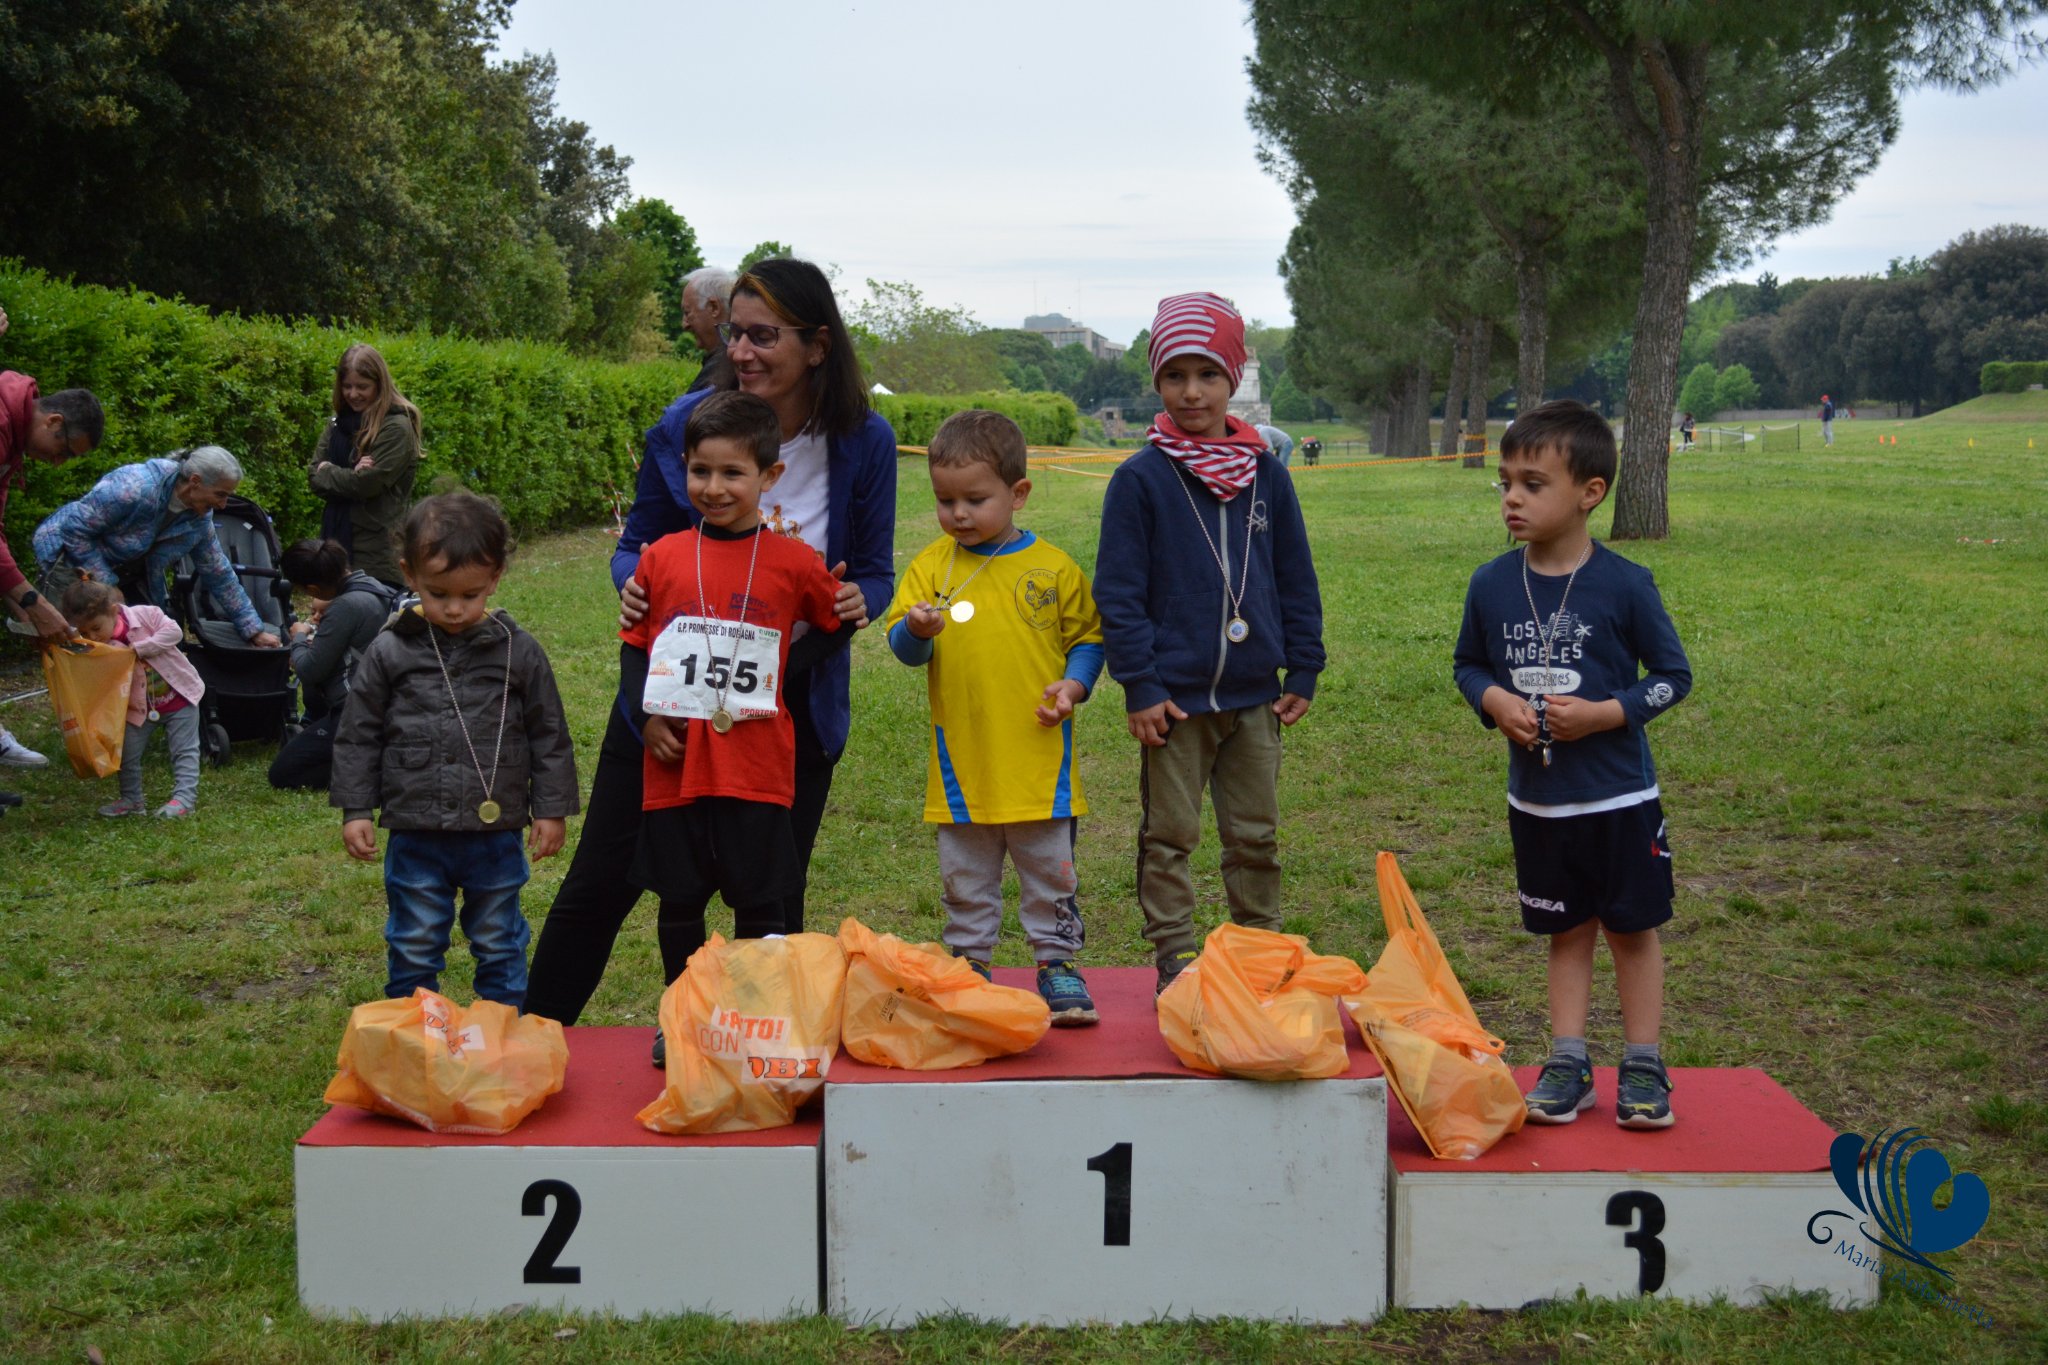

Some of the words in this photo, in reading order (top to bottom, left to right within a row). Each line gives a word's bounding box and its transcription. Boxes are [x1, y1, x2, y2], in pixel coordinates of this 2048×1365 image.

[677, 622, 687, 633] G.P.
[688, 623, 720, 635] PROMESSE
[720, 626, 727, 637] DI
[727, 627, 755, 640] ROMAGNA
[1503, 620, 1534, 641] LOS
[1505, 642, 1583, 665] ANGELES
[680, 653, 758, 694] 155
[1518, 890, 1565, 913] LEGEA
[719, 1010, 784, 1040] FATO!
[700, 1028, 739, 1054] CON
[1087, 1142, 1133, 1247] 1
[521, 1179, 582, 1284] 2
[1605, 1190, 1666, 1296] 3
